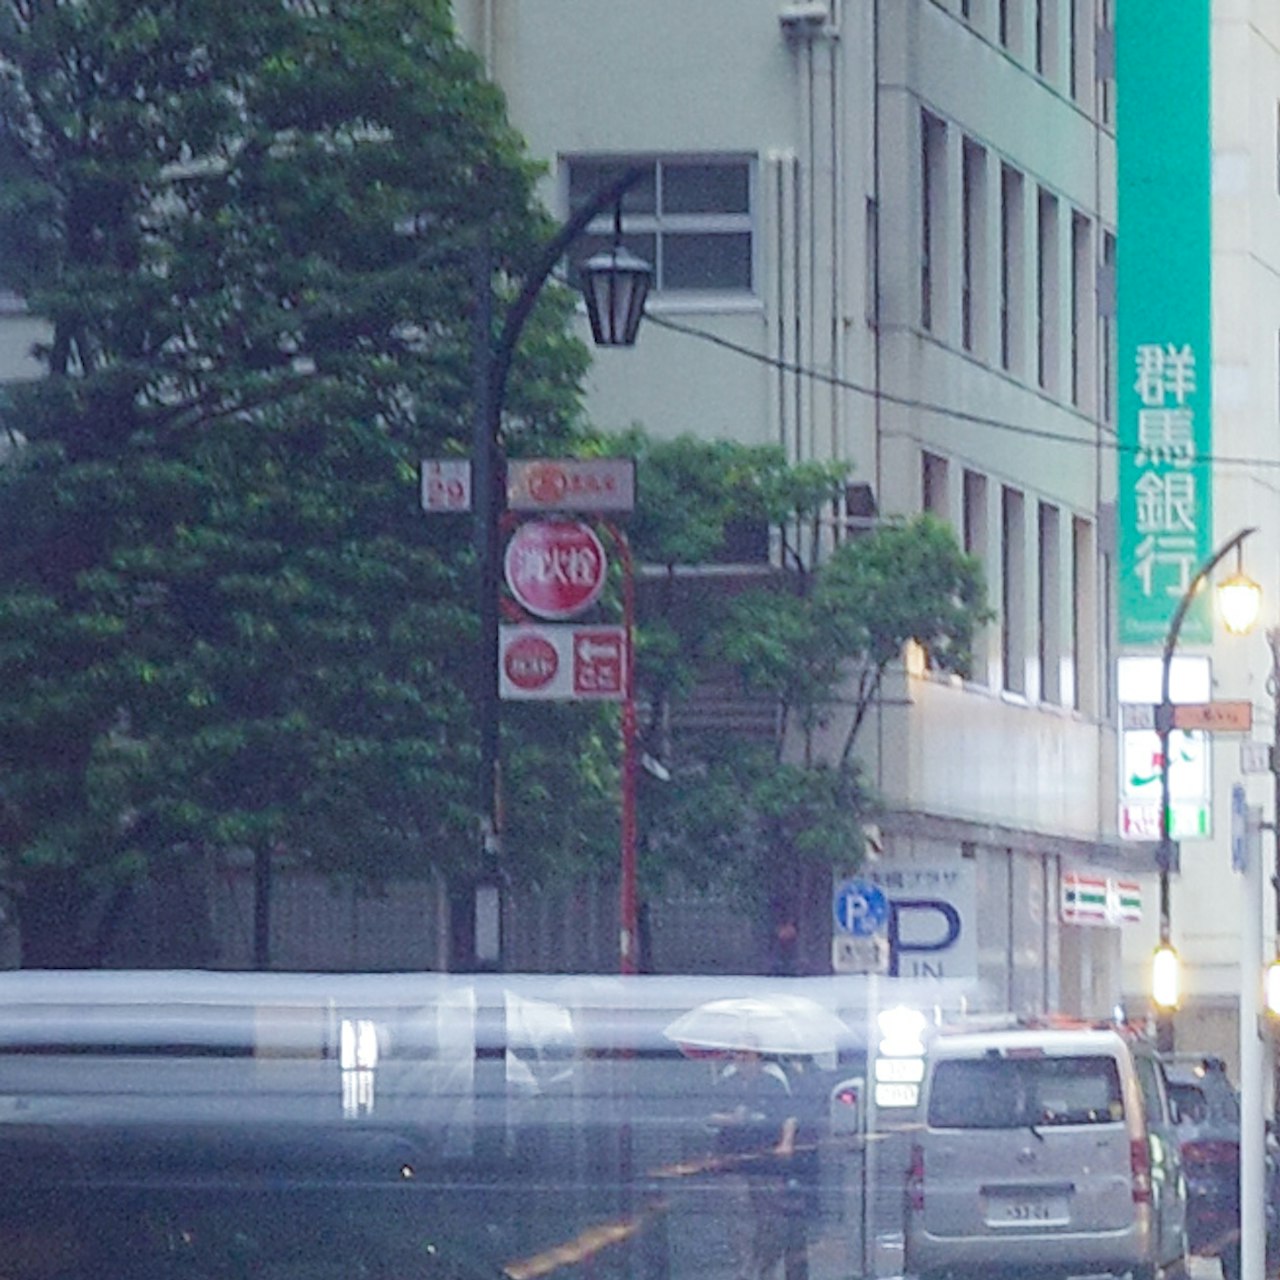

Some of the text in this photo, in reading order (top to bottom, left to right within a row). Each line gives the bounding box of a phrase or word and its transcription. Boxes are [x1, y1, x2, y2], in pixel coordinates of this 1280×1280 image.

[1134, 342, 1196, 597] 群馬銀行
[517, 546, 597, 586] 消火栓
[887, 897, 961, 978] P
[912, 961, 943, 979] IN
